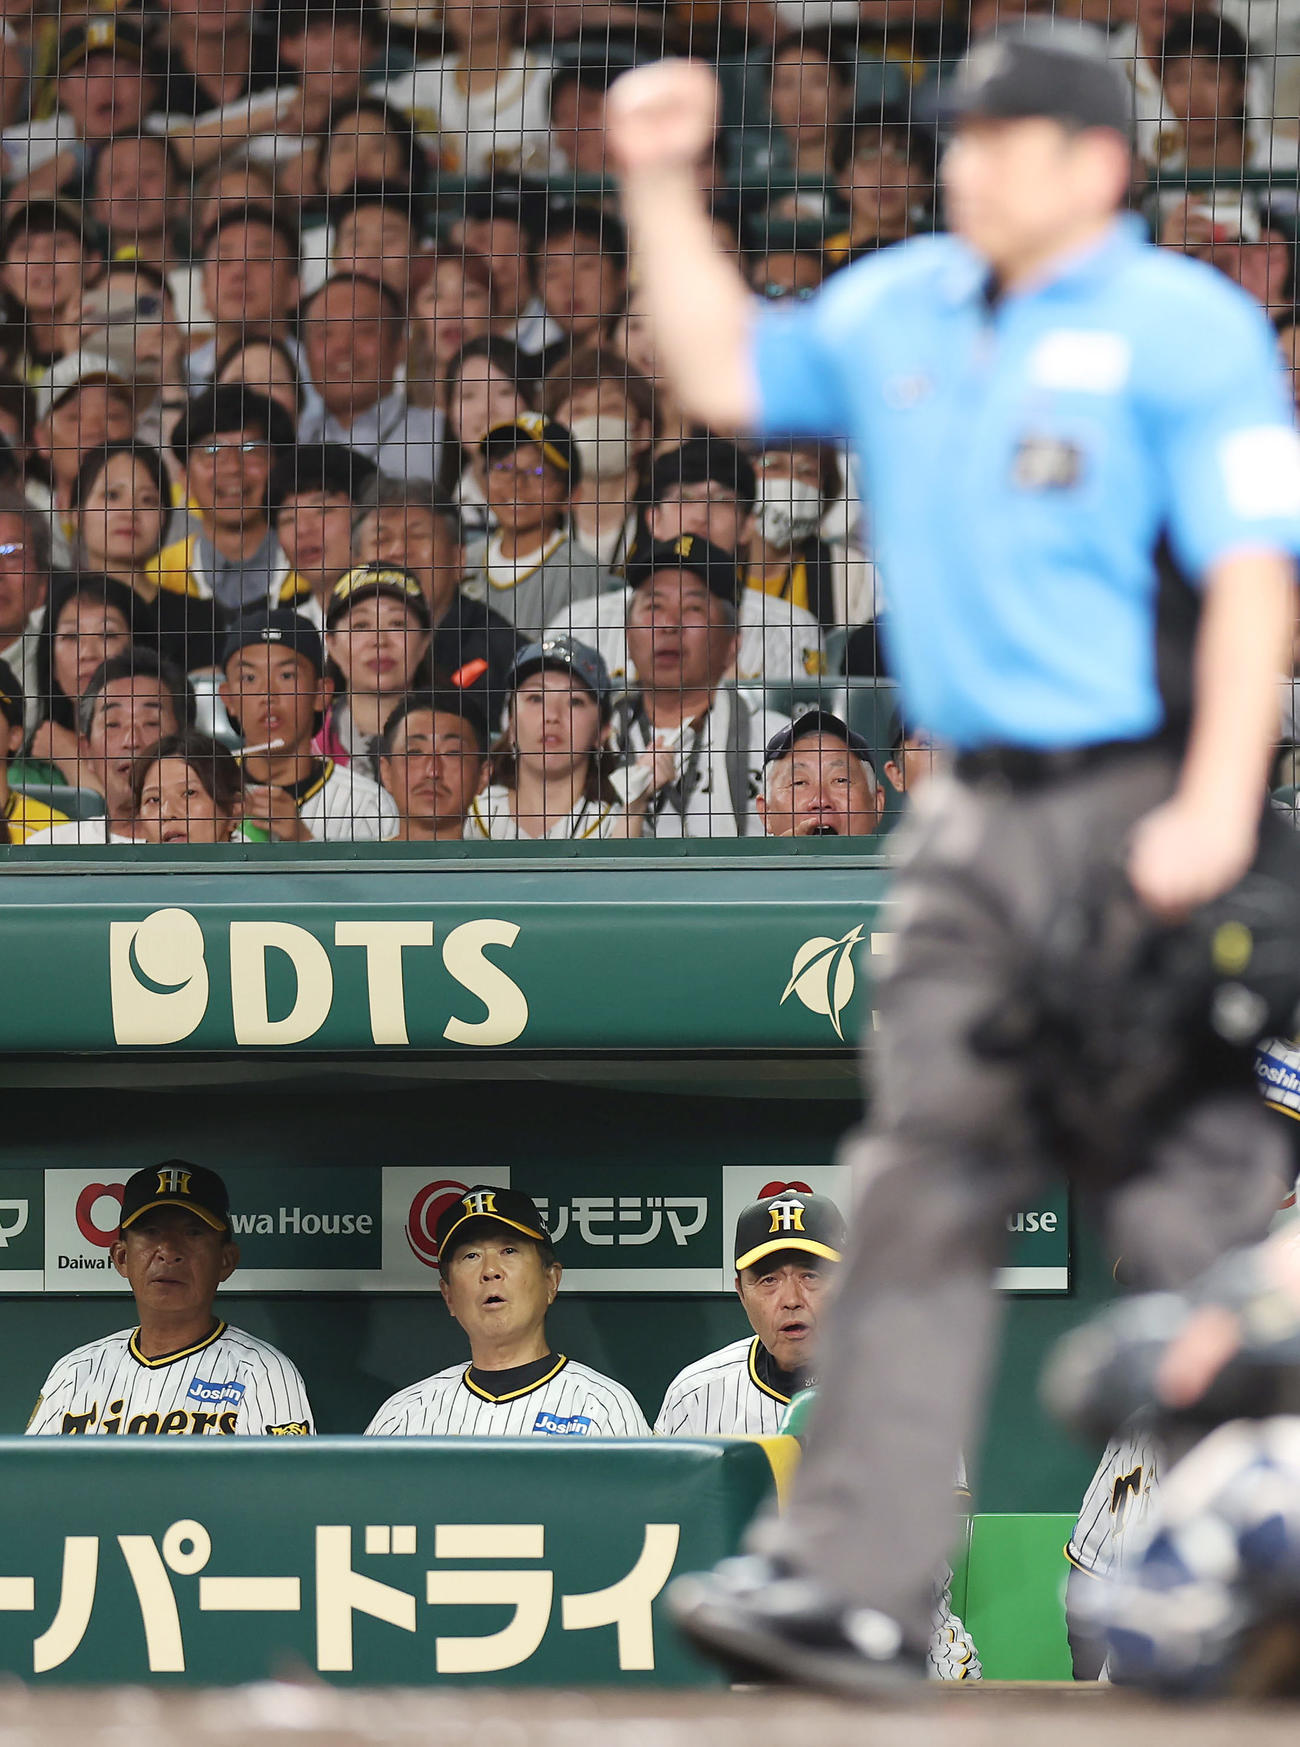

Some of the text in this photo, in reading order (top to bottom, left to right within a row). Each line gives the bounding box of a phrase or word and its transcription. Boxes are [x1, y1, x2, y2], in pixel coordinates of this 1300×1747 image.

[229, 919, 529, 1046] DTS
[279, 1207, 373, 1234] House
[532, 1197, 708, 1246] シモジマ
[58, 1254, 105, 1269] Daiwa
[189, 1383, 241, 1402] Joshin
[535, 1415, 588, 1434] Joshin
